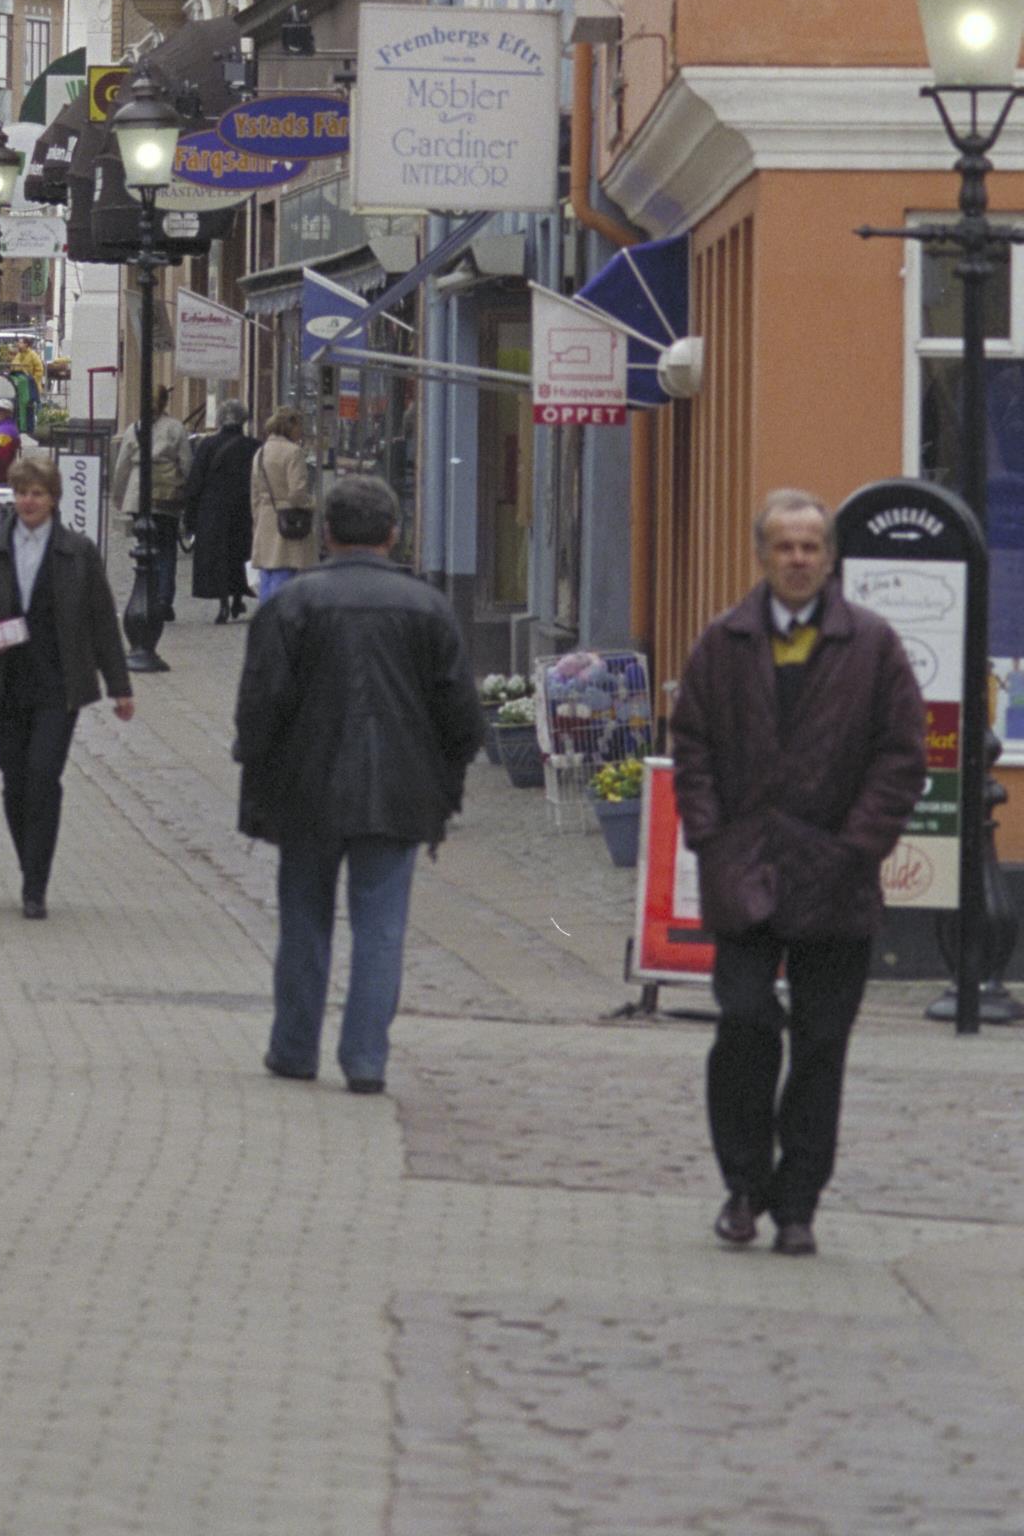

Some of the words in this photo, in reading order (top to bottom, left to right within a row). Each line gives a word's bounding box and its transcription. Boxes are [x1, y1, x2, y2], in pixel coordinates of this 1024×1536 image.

[377, 25, 490, 66] Frembergs
[407, 77, 510, 110] Möbler
[234, 113, 310, 138] Ystads
[314, 111, 350, 138] Fär
[391, 127, 519, 160] Gardiner
[402, 161, 509, 187] INTERIÖR
[553, 385, 624, 401] Husqvarna
[541, 404, 620, 424] ÖPPET
